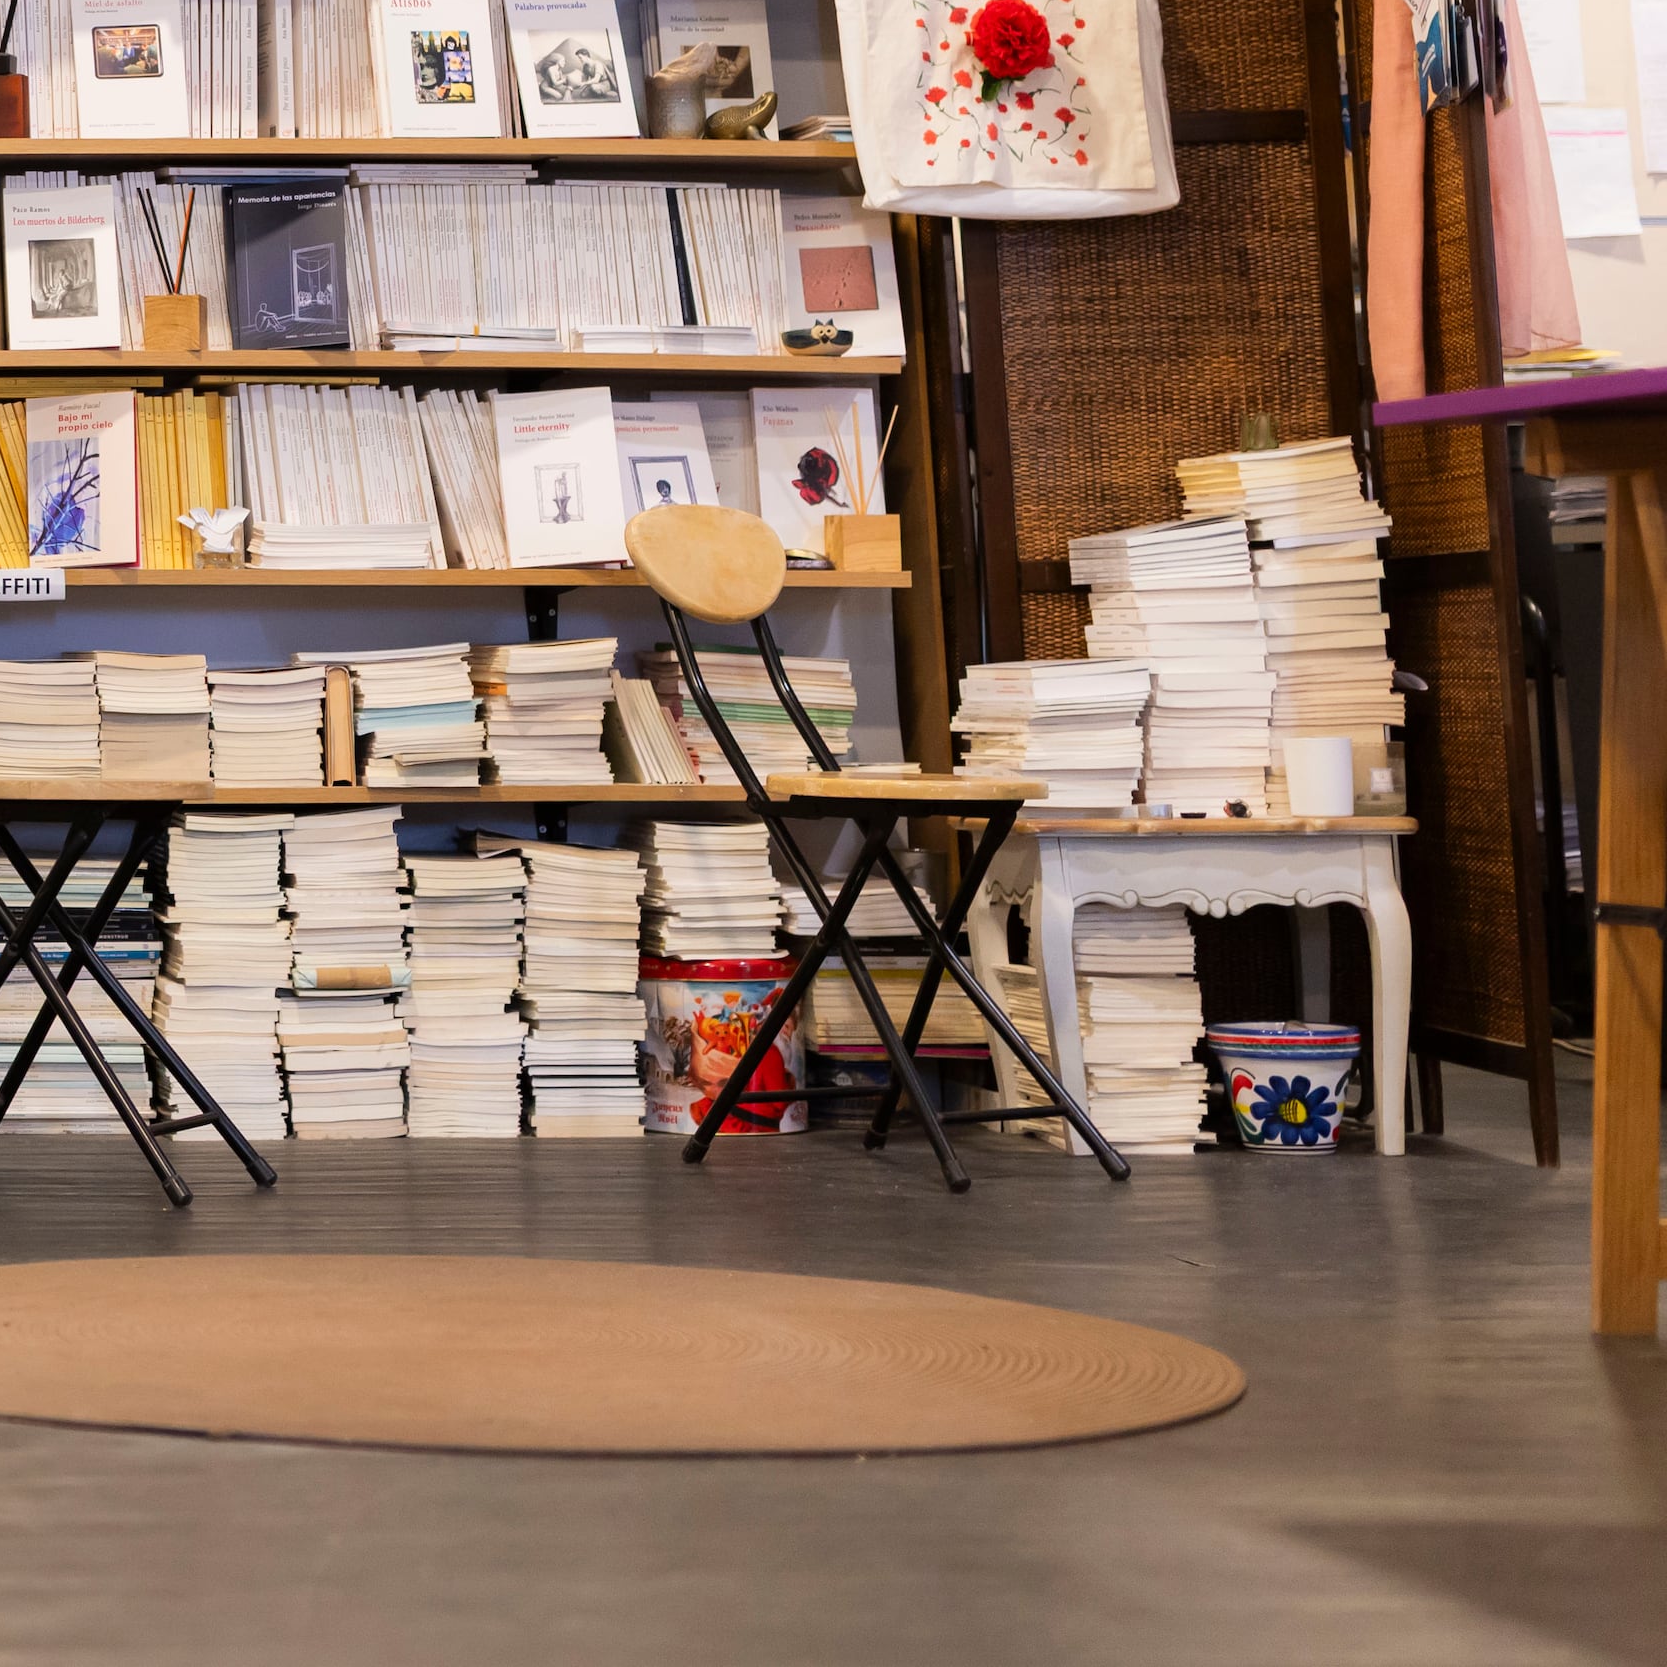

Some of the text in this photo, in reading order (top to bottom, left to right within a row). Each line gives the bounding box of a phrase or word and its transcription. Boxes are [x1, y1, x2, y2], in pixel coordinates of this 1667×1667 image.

[84, 0, 143, 8] Miel de asfalto
[514, 1, 587, 13] Palabras provocadas
[237, 190, 336, 205] Memoria de las apariencias
[12, 206, 51, 214] Paco Ramos
[12, 214, 105, 227] Los muertos de Bilderberg
[58, 412, 93, 424] Bajo mi
[58, 420, 113, 434] propio cielo
[514, 422, 571, 434] Little eternity
[657, 1114, 678, 1124] Noël
